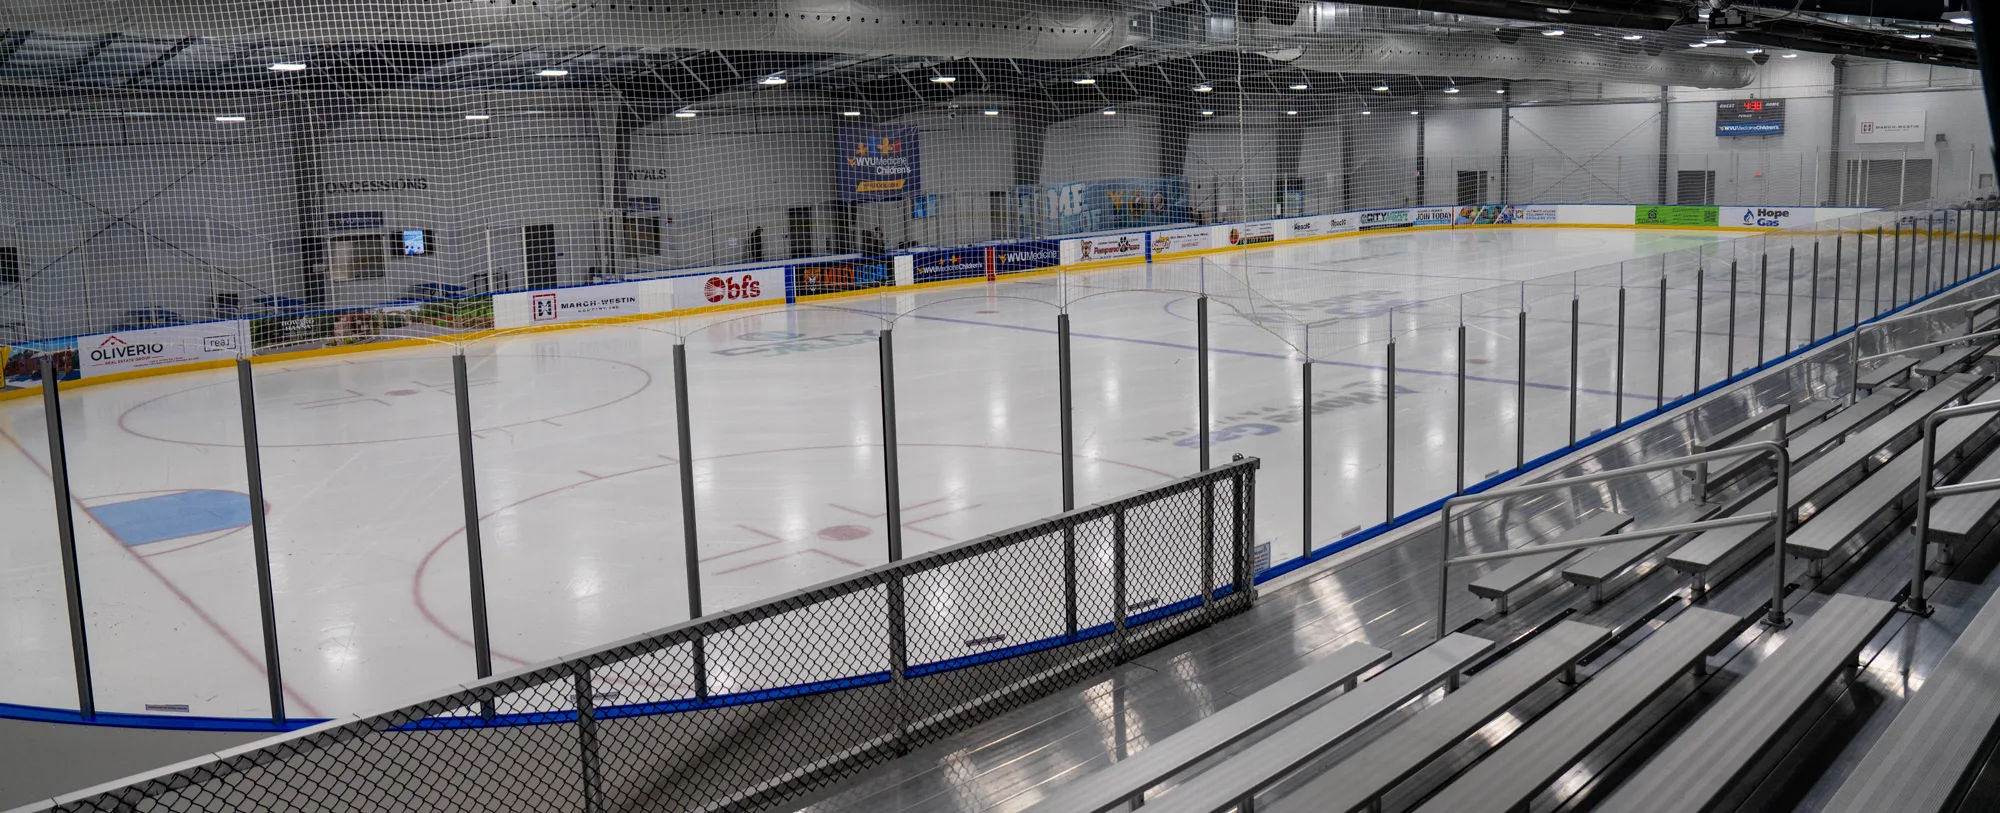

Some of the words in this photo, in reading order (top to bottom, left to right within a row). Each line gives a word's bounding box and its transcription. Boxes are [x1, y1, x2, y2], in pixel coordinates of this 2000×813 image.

[628, 169, 667, 180] NTALS
[325, 177, 428, 194] ONCESSIONS
[1415, 213, 1431, 221] JOIN
[1432, 212, 1452, 220] TODAY
[1757, 208, 1790, 219] Hope
[1757, 218, 1780, 227] Gas
[725, 274, 761, 300] bfs
[561, 297, 636, 309] MARCH-WESTIN
[90, 343, 164, 361] OLIVERIO
